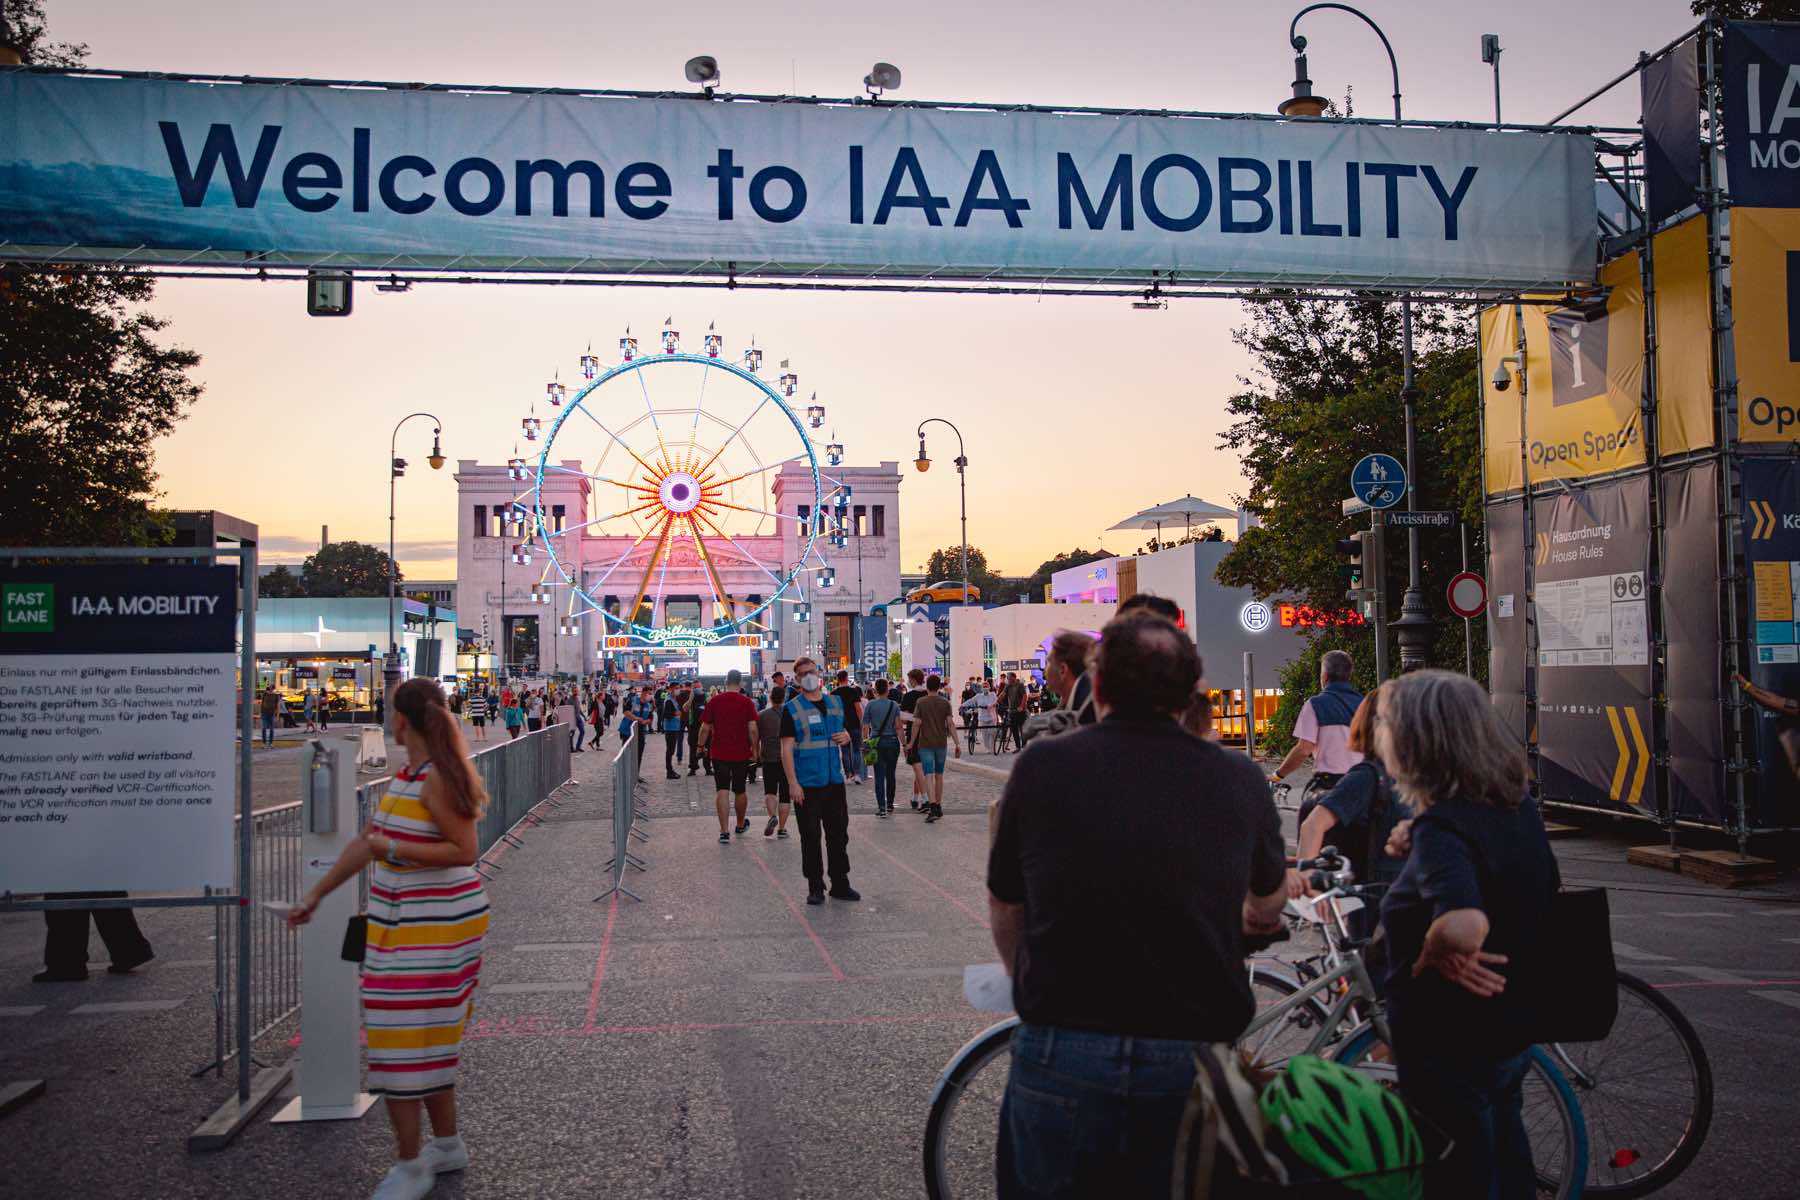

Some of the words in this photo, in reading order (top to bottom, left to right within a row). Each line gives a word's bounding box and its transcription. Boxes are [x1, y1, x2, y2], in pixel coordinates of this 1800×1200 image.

[159, 121, 672, 220] Welcome
[707, 148, 807, 224] to
[849, 145, 1030, 229] IAA
[1057, 152, 1478, 242] MOBILITY
[1749, 397, 1800, 434] Op
[1530, 441, 1579, 469] Open
[1583, 427, 1638, 461] Space
[1389, 513, 1449, 526] Arcisstraße
[1552, 524, 1612, 544] Hausordnung
[1552, 549, 1577, 563] House
[1580, 545, 1604, 559] Rules
[7, 592, 45, 605] FAST
[71, 596, 114, 616] IAA
[118, 595, 220, 616] MOBILITY
[7, 609, 48, 623] LANE
[663, 640, 707, 648] RIESENRAD
[1, 667, 37, 678] Einlass
[40, 669, 57, 677] nur
[61, 667, 79, 677] mit
[80, 666, 127, 679] gültigem
[0, 686, 18, 696] Die
[21, 685, 79, 696] FASTLANE
[81, 685, 93, 695] ist
[97, 685, 111, 695] für
[114, 685, 132, 695] alle
[135, 684, 184, 695] Besucher
[187, 684, 205, 694] mit
[0, 700, 38, 709] bereits
[40, 698, 99, 711] geprüftem
[0, 713, 17, 722] Die
[88, 713, 116, 721] muss
[119, 712, 135, 721] für
[136, 711, 168, 723] jeden
[171, 710, 190, 723] Tag
[192, 710, 215, 720] ein-
[31, 728, 53, 736] neu
[56, 752, 79, 764] only
[82, 752, 104, 761] with
[107, 751, 135, 761] valid
[21, 771, 77, 781] FASTLANE
[80, 773, 100, 781] can
[103, 771, 117, 780] be
[120, 770, 146, 780] used
[148, 769, 161, 781] by
[164, 768, 178, 779] all
[180, 768, 217, 779] visitors
[24, 784, 68, 797] already
[71, 783, 114, 794] verified
[0, 800, 17, 809] he
[21, 799, 45, 809] VCR
[48, 797, 108, 808] verification
[110, 797, 137, 807] must
[140, 797, 153, 807] be
[156, 796, 183, 806] done
[186, 797, 213, 806] once
[0, 814, 12, 823] or
[15, 812, 43, 823] each
